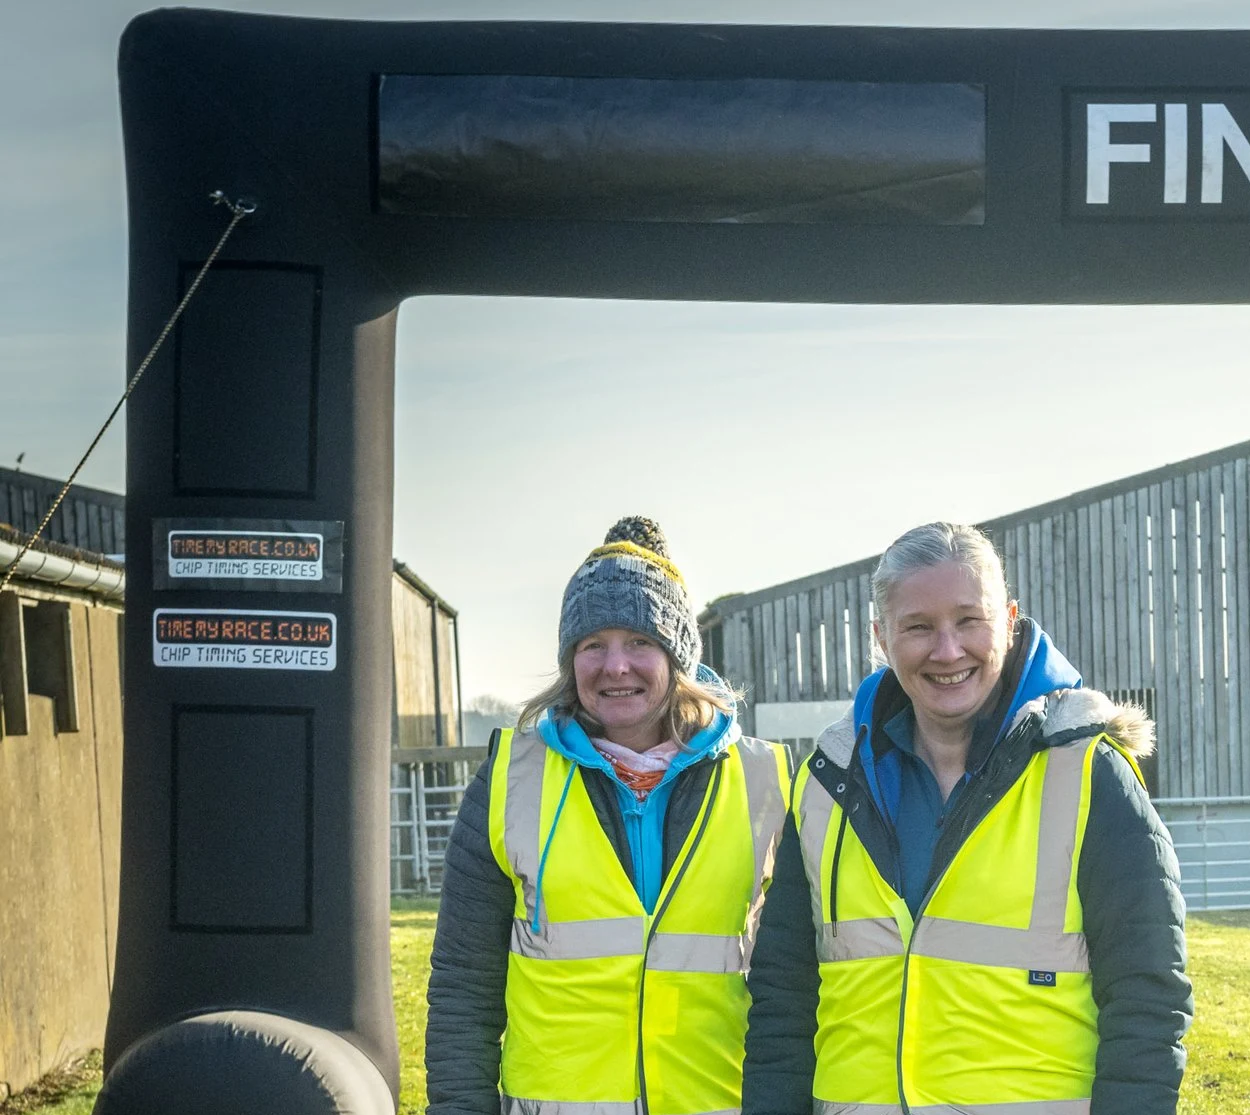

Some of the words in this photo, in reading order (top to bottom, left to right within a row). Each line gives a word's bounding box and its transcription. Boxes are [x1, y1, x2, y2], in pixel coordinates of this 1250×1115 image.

[175, 561, 203, 575] CHIP
[207, 561, 249, 576] TIMING
[252, 562, 317, 577] SERVICES
[161, 646, 192, 662] CHIP
[197, 647, 247, 663] TIMING
[252, 648, 329, 666] SERVICES
[1032, 972, 1053, 982] LEO
